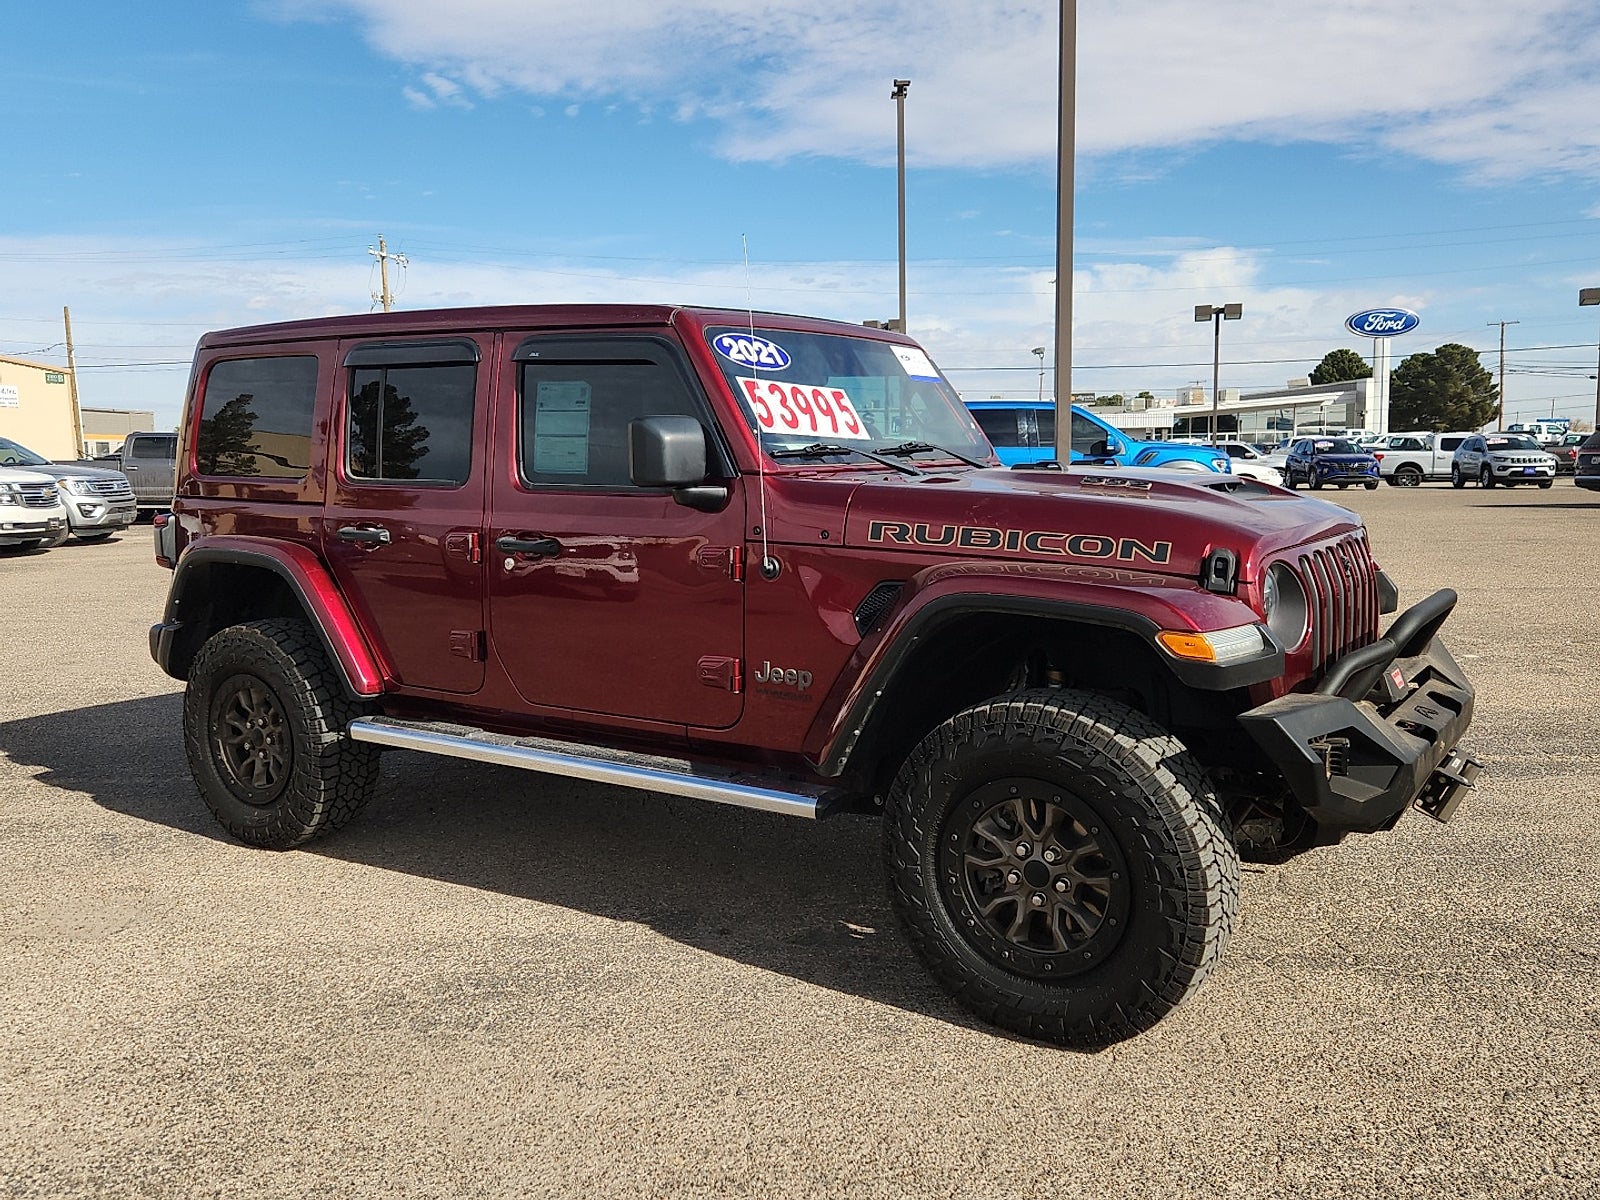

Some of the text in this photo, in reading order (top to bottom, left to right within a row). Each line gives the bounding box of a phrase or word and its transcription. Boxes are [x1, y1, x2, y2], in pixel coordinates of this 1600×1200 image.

[1364, 313, 1407, 331] Ford
[722, 337, 785, 367] 2021
[742, 380, 860, 435] 53995
[867, 520, 1172, 565] RUBICON
[754, 660, 813, 691] Jeep
